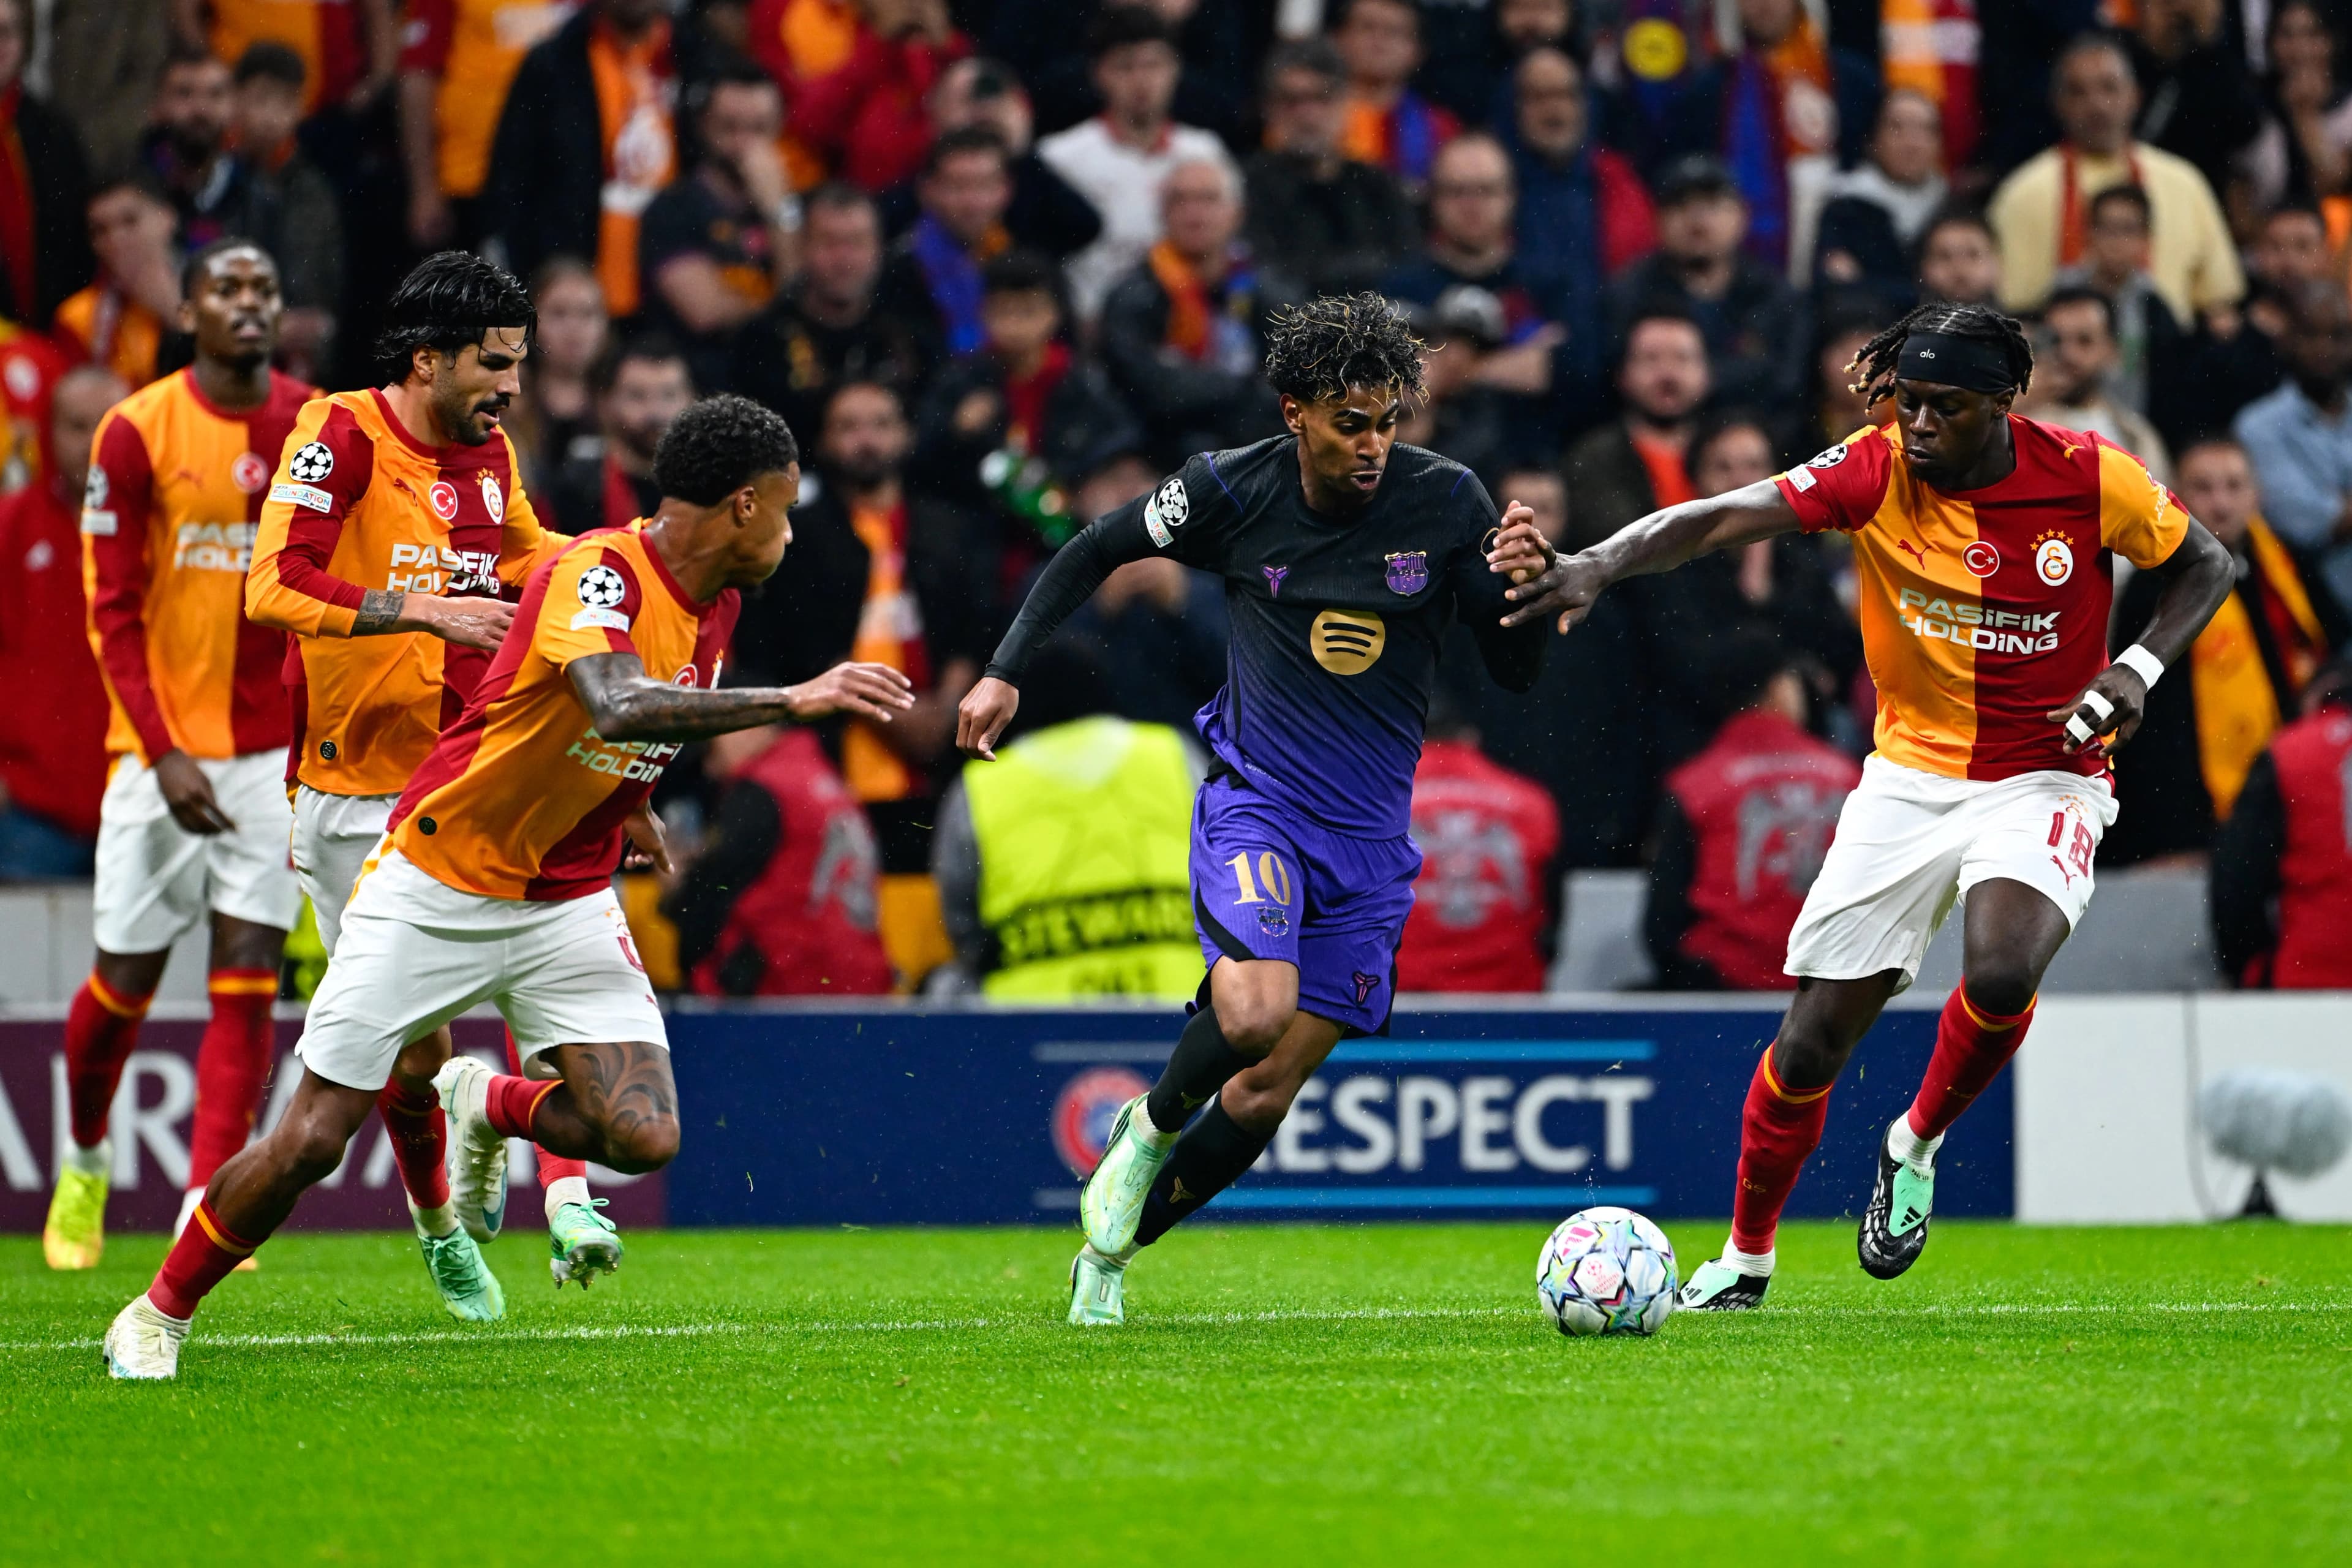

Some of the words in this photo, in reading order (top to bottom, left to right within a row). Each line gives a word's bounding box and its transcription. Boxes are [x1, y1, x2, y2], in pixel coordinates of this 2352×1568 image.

[1920, 349, 1935, 359] alo
[273, 489, 330, 507] FOUNDATION
[2047, 812, 2094, 878] 18
[1225, 851, 1291, 905] 10
[1204, 1076, 1654, 1172] ESPECT
